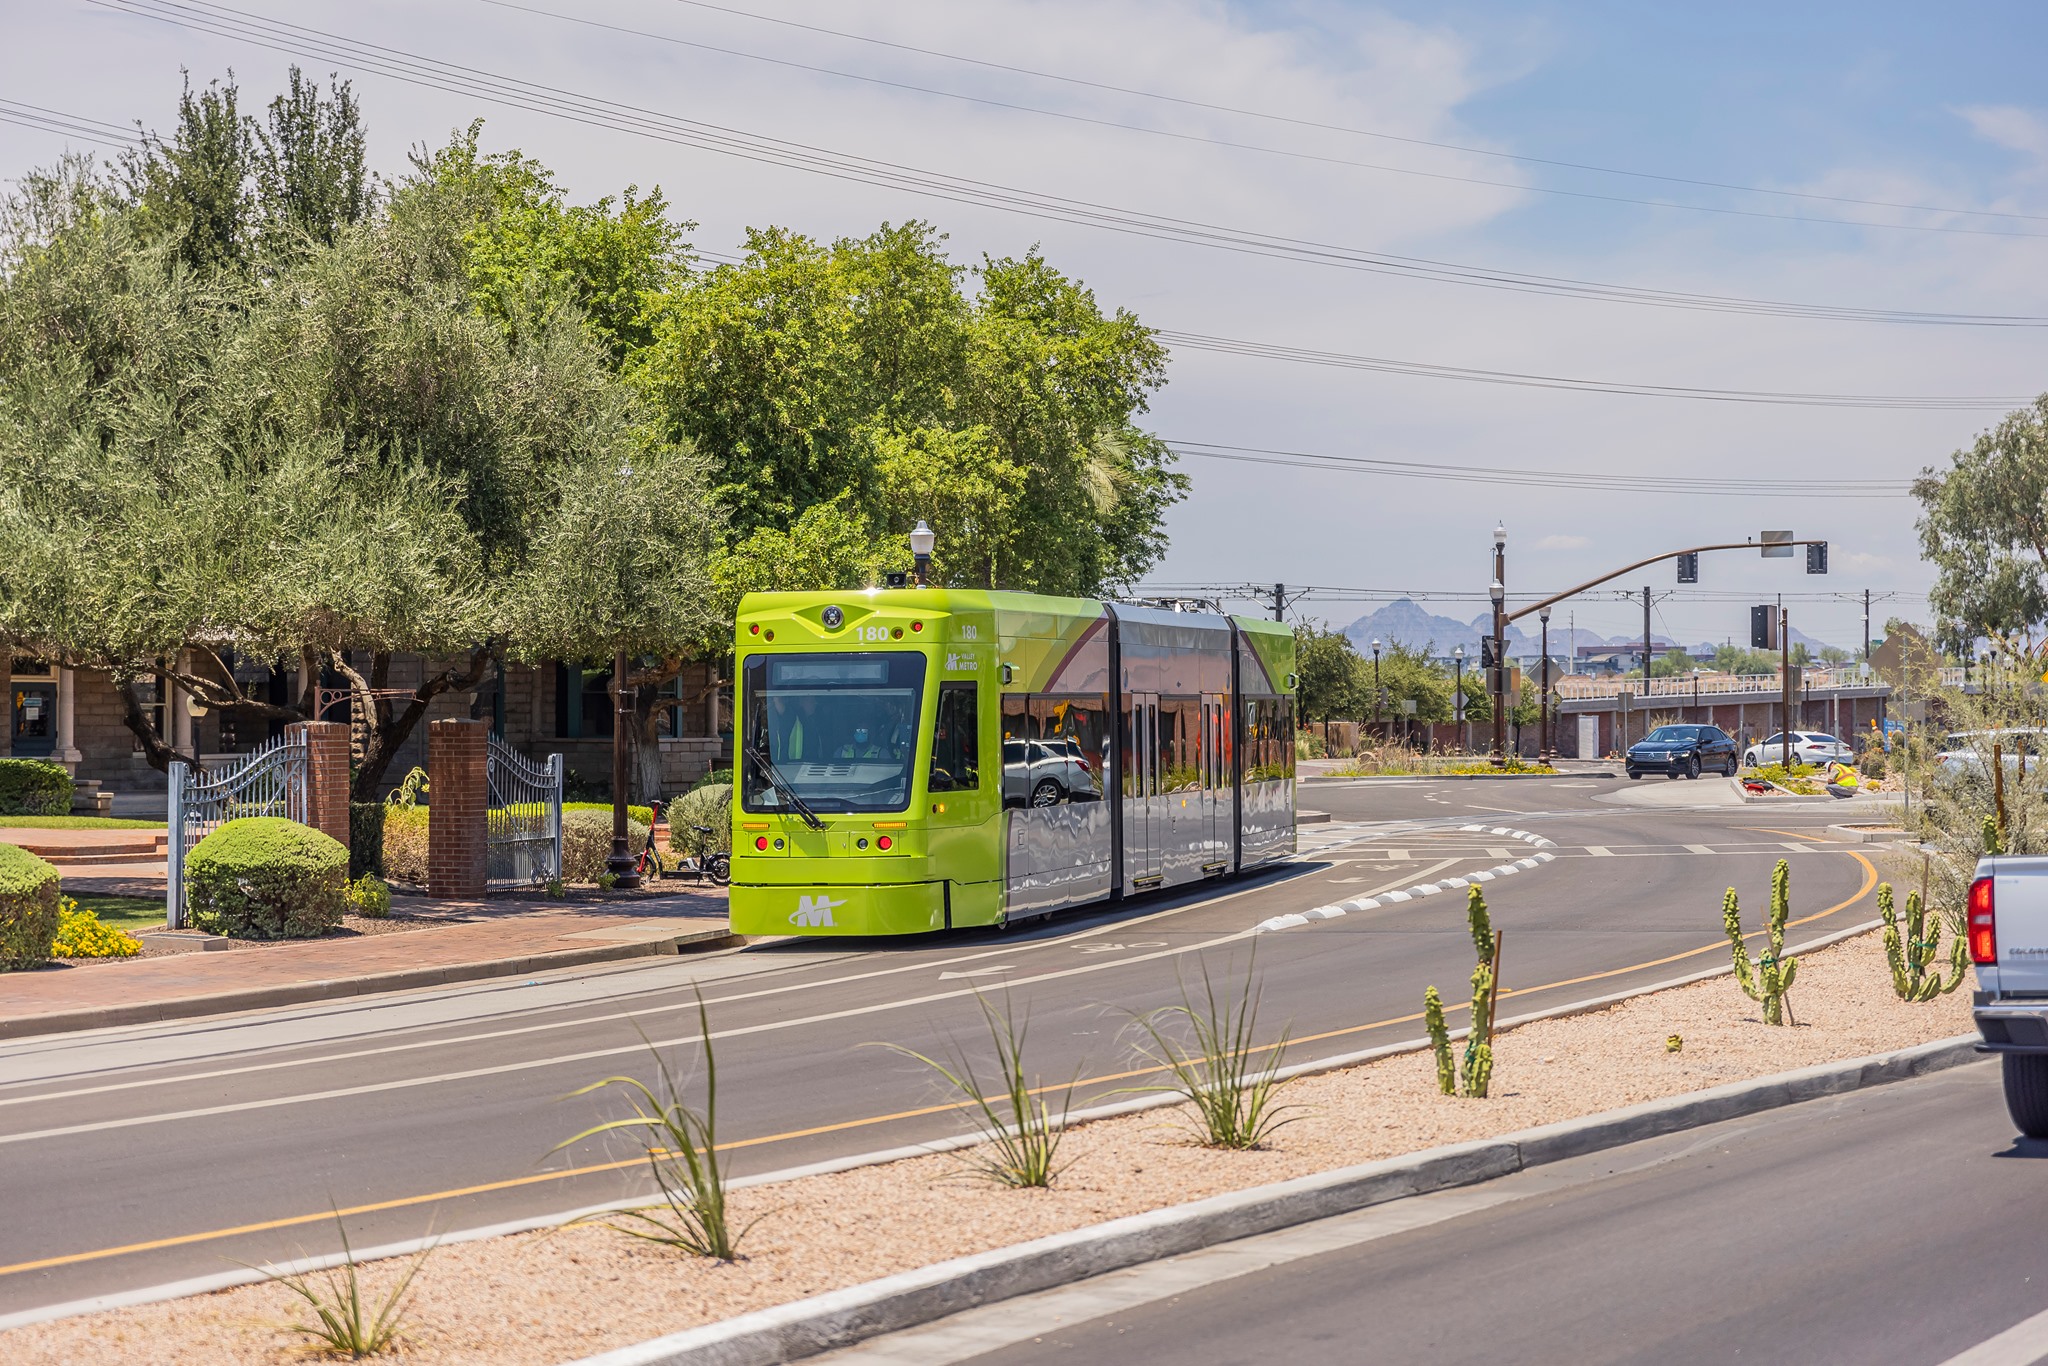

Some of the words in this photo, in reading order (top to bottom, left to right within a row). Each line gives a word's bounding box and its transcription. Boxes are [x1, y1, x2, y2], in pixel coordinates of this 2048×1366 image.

[856, 626, 889, 641] 180
[961, 625, 977, 639] 180
[959, 661, 978, 671] METRO
